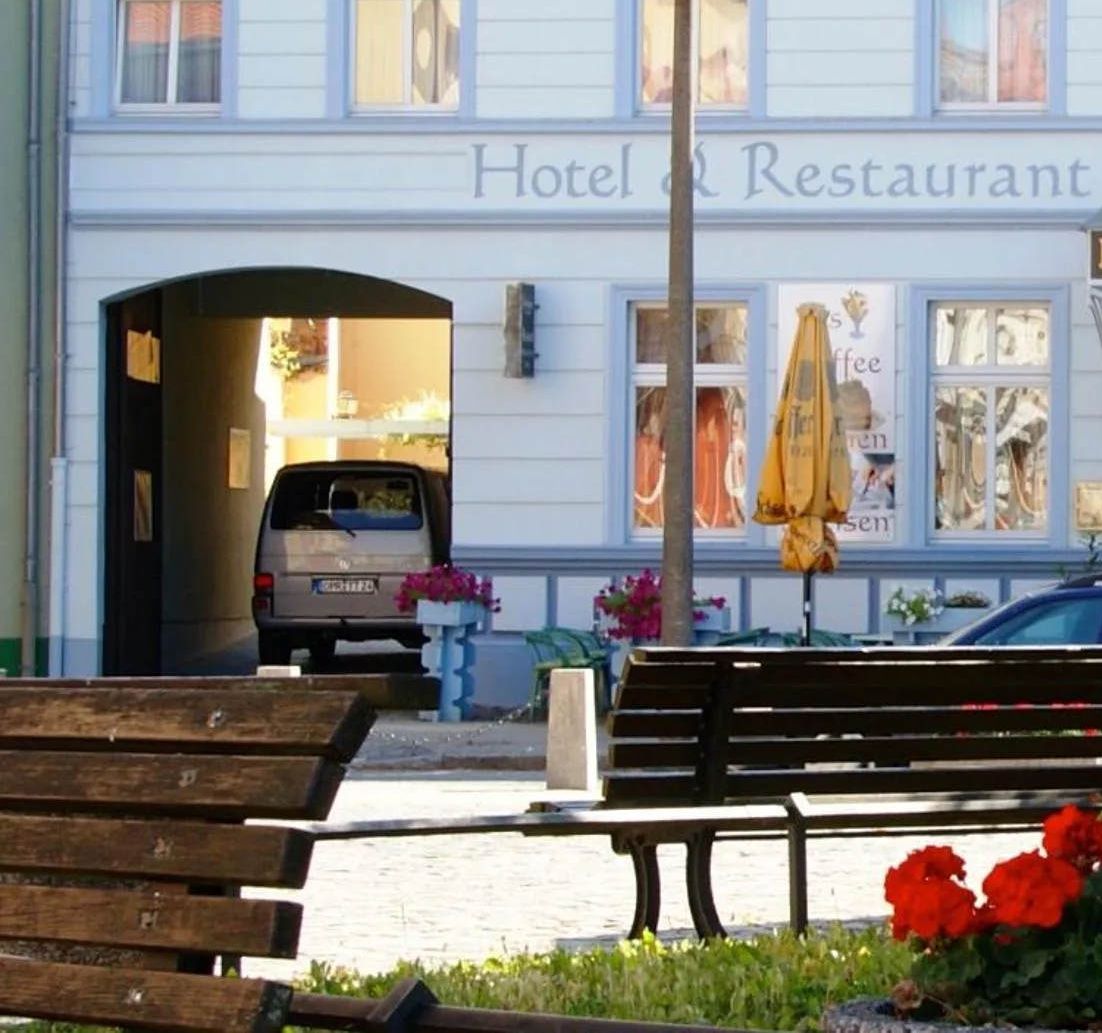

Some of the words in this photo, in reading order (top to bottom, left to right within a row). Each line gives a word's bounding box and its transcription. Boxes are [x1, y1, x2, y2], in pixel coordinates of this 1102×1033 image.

[471, 142, 633, 199] Hotel
[660, 141, 720, 198] &
[741, 141, 1092, 200] Restaurant
